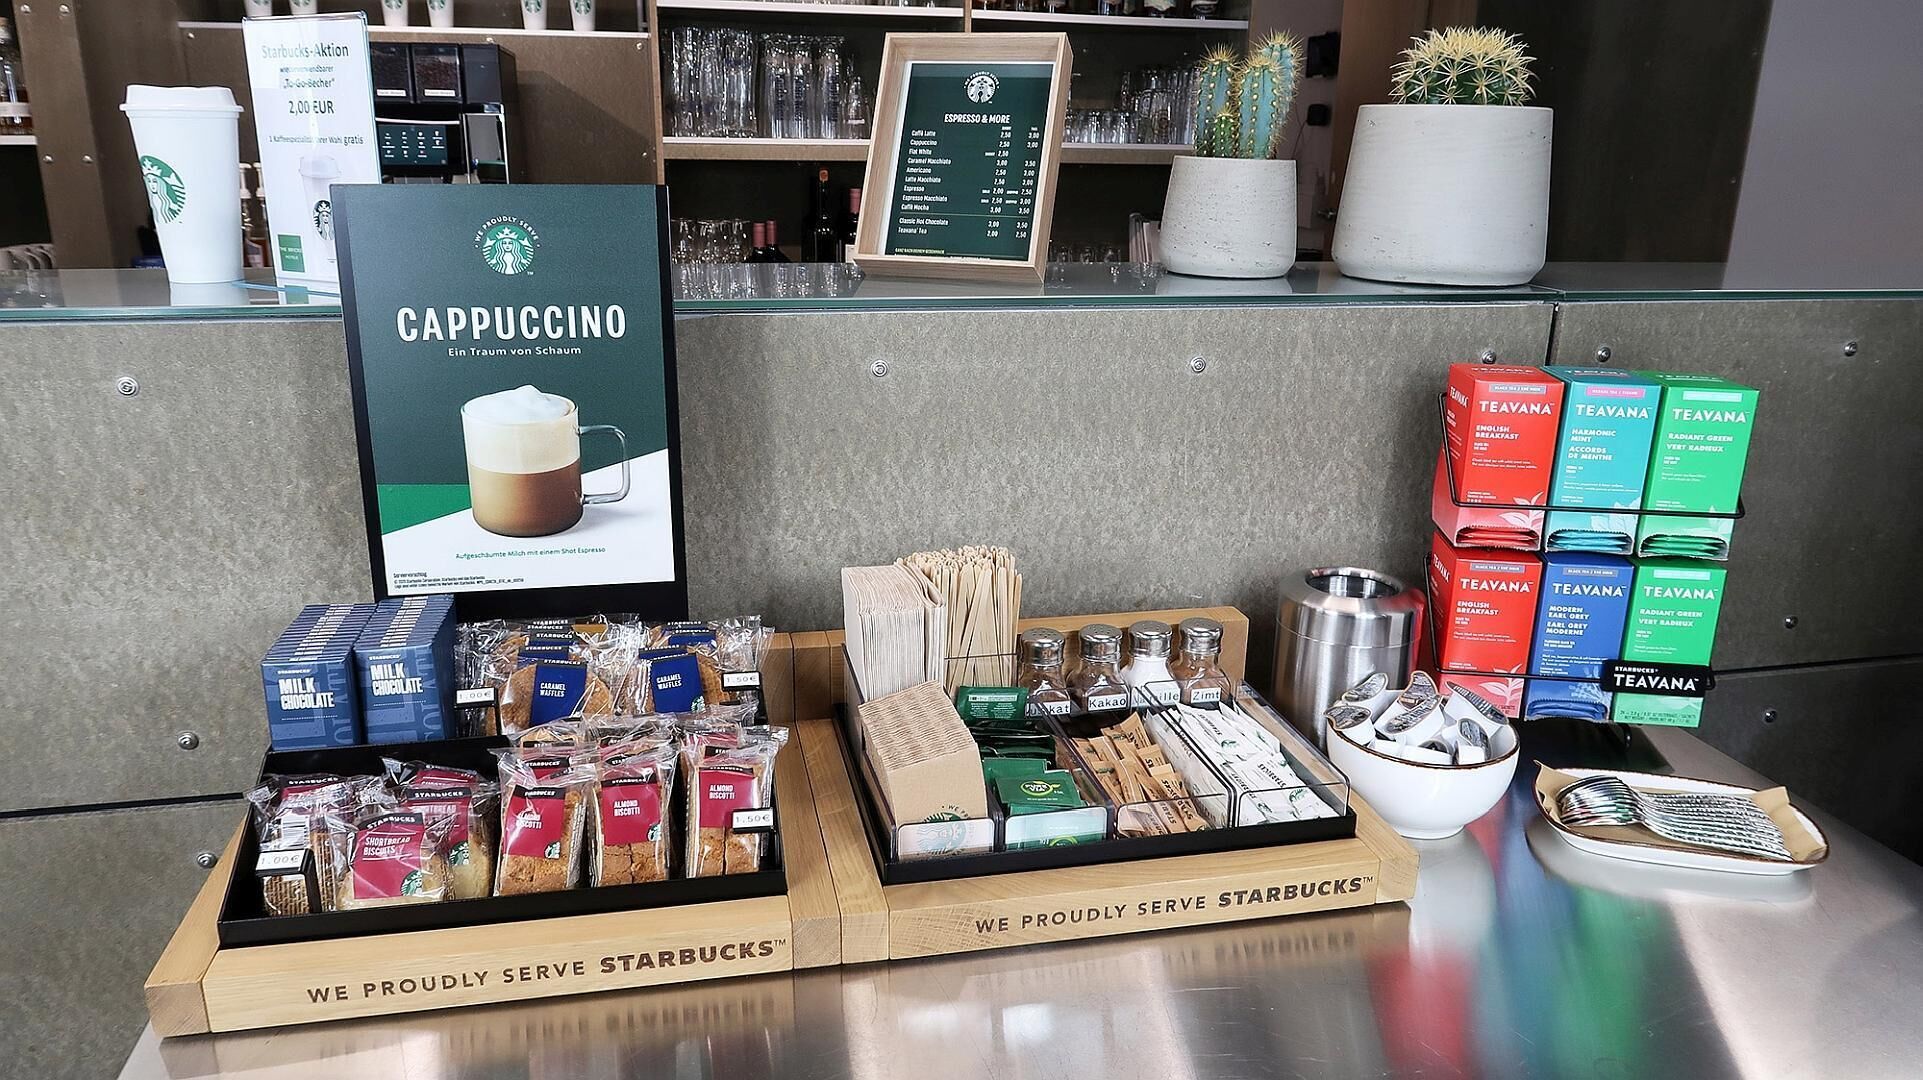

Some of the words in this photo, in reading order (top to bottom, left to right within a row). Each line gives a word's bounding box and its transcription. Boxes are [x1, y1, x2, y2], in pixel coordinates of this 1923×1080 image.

[262, 42, 349, 59] Starbucks-Aktion
[289, 100, 310, 116] 2,00
[313, 100, 334, 114] EUR
[944, 113, 980, 123] ESPRESSO
[981, 114, 988, 123] &
[989, 114, 1010, 124] MORE
[344, 134, 364, 147] gratis
[474, 230, 484, 242] WE
[482, 216, 517, 230] PROUDLY
[519, 220, 540, 241] SERVE
[396, 303, 626, 342] CAPPUCCINO
[448, 347, 467, 357] Ein
[470, 346, 507, 357] Traum
[510, 347, 532, 356] von
[535, 345, 582, 356] Schaum
[1479, 401, 1552, 415] TEAVANA
[1576, 404, 1649, 418] TEAVANA
[1673, 408, 1746, 423] TEAVANA
[1476, 424, 1510, 432] ENGLISH
[1572, 428, 1617, 437] HARMONIC
[1475, 432, 1520, 440] BREAKFAST
[1571, 435, 1592, 443] MINT
[1668, 433, 1705, 441] RADIANT
[1706, 434, 1734, 442] GREEN
[1569, 446, 1607, 454] ACCORDS
[540, 548, 560, 556] einem
[578, 546, 606, 554] Espresso
[1460, 578, 1530, 592] TEAVANA
[1552, 583, 1623, 597] TEAVANA
[1643, 586, 1715, 600] TEAVANA
[1456, 607, 1499, 615] BREAKFAST
[1549, 605, 1583, 613] MODERN
[1639, 608, 1675, 616] RADIANT
[1659, 619, 1694, 627] RADIEUX
[370, 662, 405, 680] MILK
[657, 673, 682, 683] CARAMEL
[1614, 674, 1696, 691] TEAVANA
[279, 677, 316, 694] MILK
[372, 677, 423, 696] CHOCOLATE
[540, 682, 566, 690] CARAMEL
[658, 680, 682, 689] WAFFLES
[540, 689, 564, 697] WAFFLES
[1132, 692, 1179, 704] Vaille
[1192, 691, 1220, 701] Zimt
[280, 692, 335, 710] CHOCOLATE
[1089, 695, 1126, 709] Kakao
[289, 777, 339, 785] STARBUCKS
[709, 784, 734, 792] ALMOND
[709, 791, 735, 799] BISCOTTI
[613, 800, 638, 808] ALMOND
[614, 806, 640, 817] BISCOTTI
[367, 816, 415, 830] STARBUCKS
[365, 836, 411, 847] SHORTBREAD
[363, 846, 396, 856] BISCUITS
[975, 918, 1009, 933] WE
[1021, 904, 1127, 929] PROUDLY
[1138, 895, 1206, 916] SERVE
[307, 985, 349, 1003] WE
[363, 970, 488, 998] PROUDLY
[503, 960, 585, 983] SERVE
